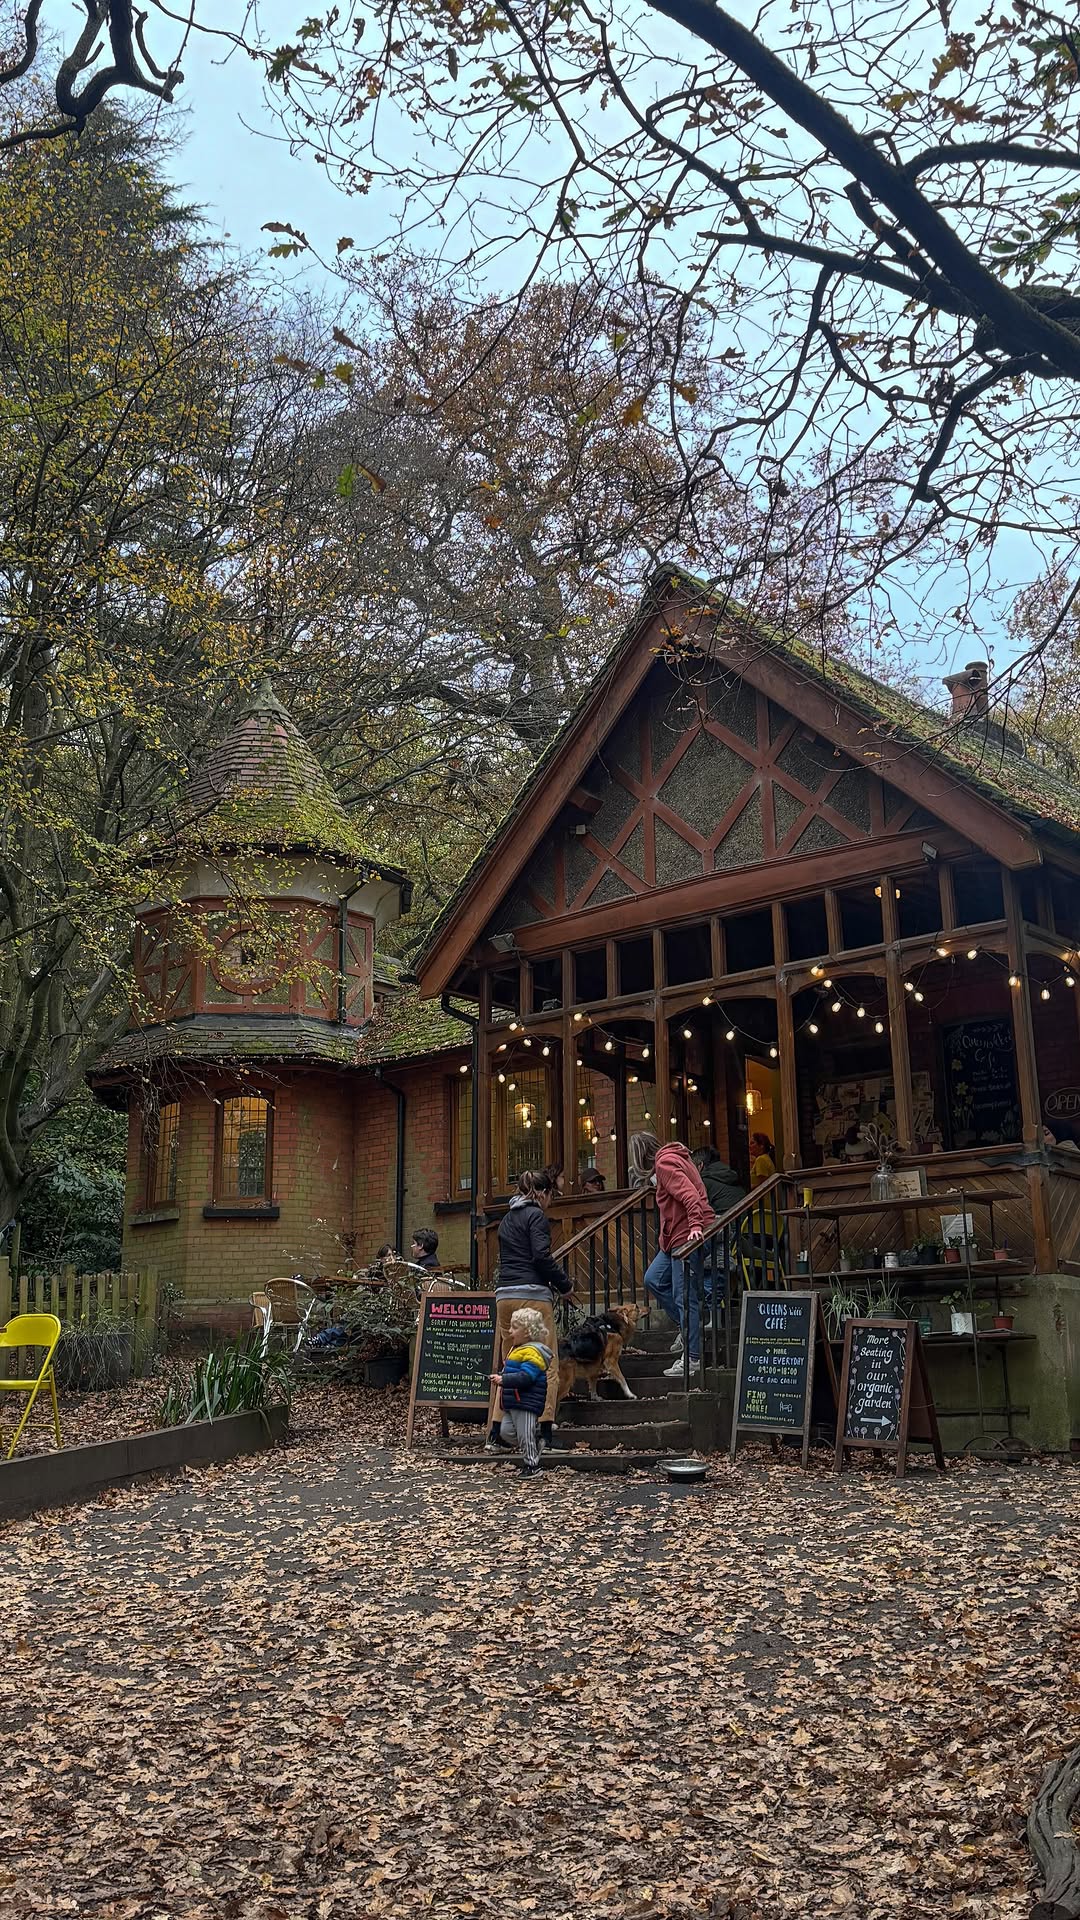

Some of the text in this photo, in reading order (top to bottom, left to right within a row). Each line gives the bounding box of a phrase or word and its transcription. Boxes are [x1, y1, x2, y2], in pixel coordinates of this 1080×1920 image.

[431, 1303, 490, 1315] WELCOME
[758, 1303, 788, 1316] QUEENS
[764, 1317, 785, 1330] CAFE
[867, 1334, 889, 1345] More
[749, 1355, 804, 1365] OPEN EVERYDAY
[860, 1347, 893, 1364] Seating
[871, 1359, 881, 1369] in
[866, 1372, 887, 1381] our
[747, 1390, 766, 1399] FIND
[857, 1382, 894, 1398] organic
[746, 1403, 768, 1414] MORE!
[854, 1396, 892, 1414] garden
